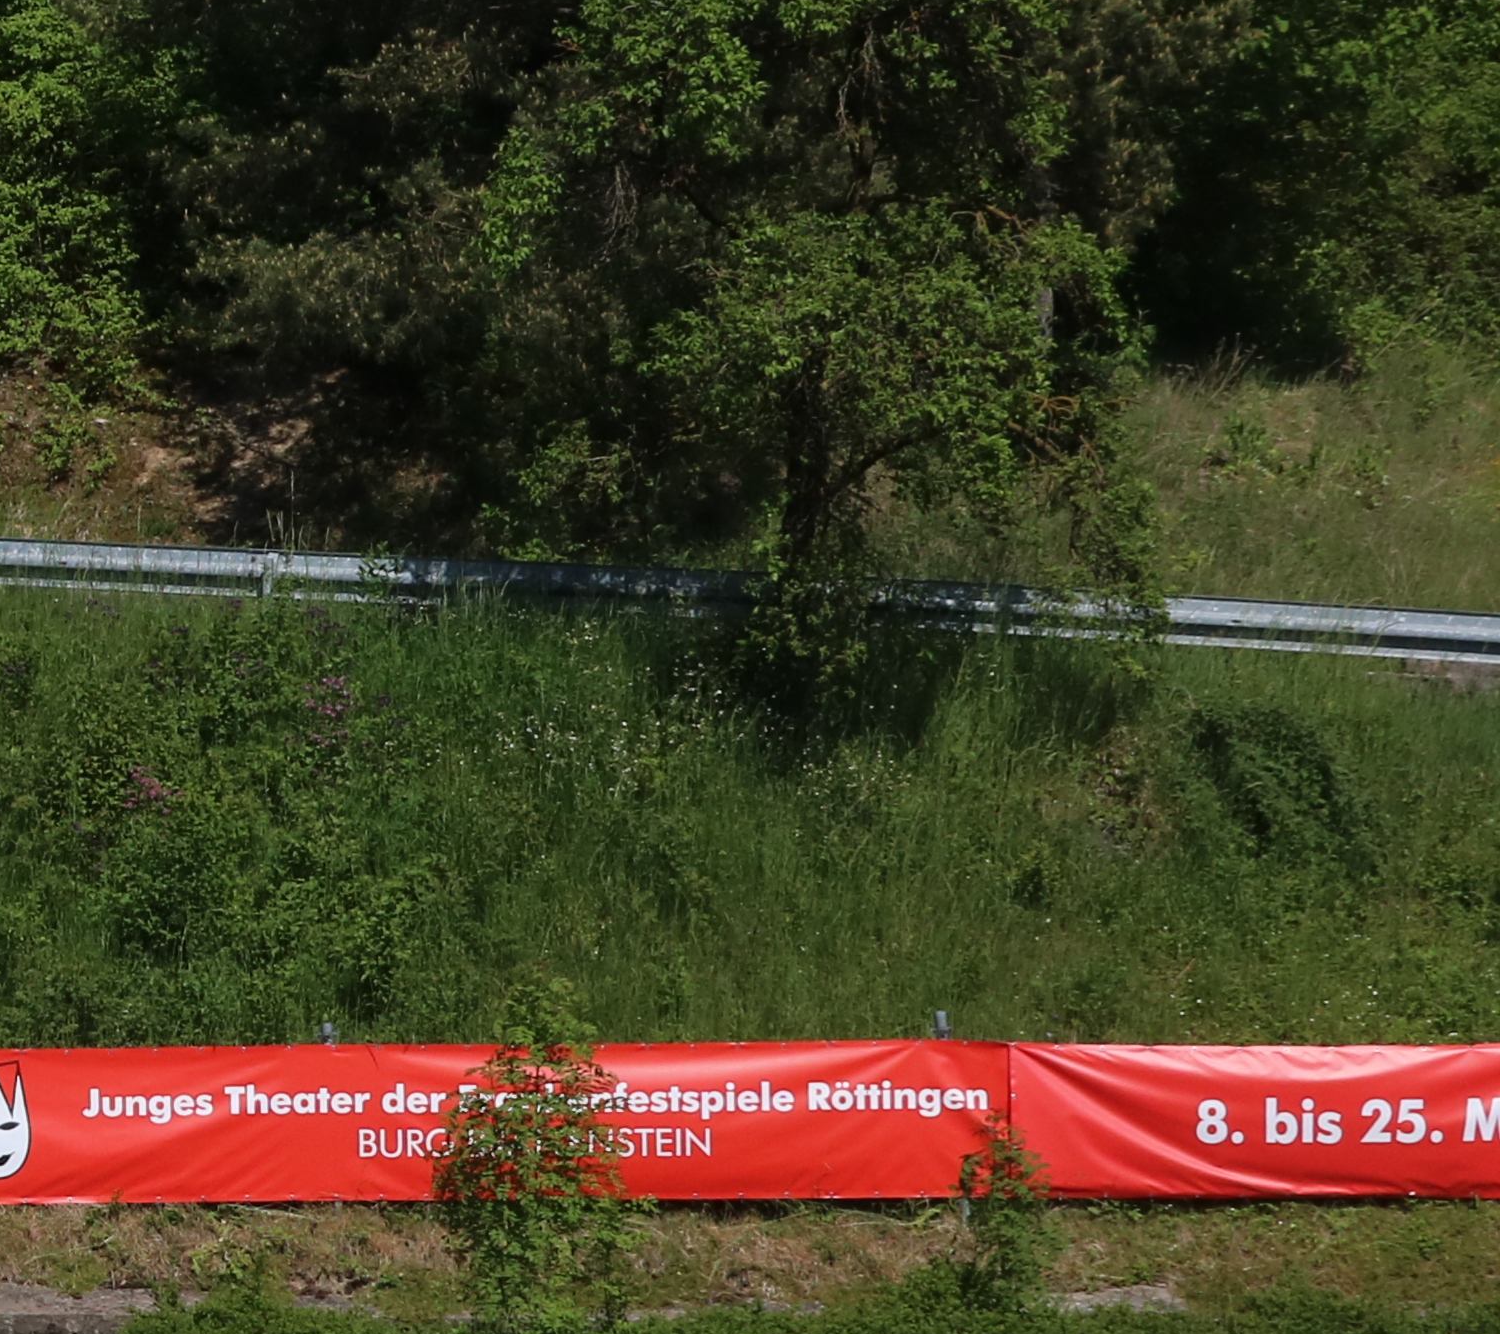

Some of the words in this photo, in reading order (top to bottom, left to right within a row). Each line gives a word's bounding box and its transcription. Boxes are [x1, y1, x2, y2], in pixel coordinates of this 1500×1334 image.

[82, 1088, 214, 1124] Junges
[224, 1084, 371, 1115] Theater
[381, 1083, 447, 1115] der
[807, 1080, 989, 1117] Röttingen
[1195, 1098, 1245, 1145] 8.
[1264, 1096, 1343, 1145] bis
[1359, 1098, 1444, 1145] 25.
[357, 1128, 455, 1158] BURG
